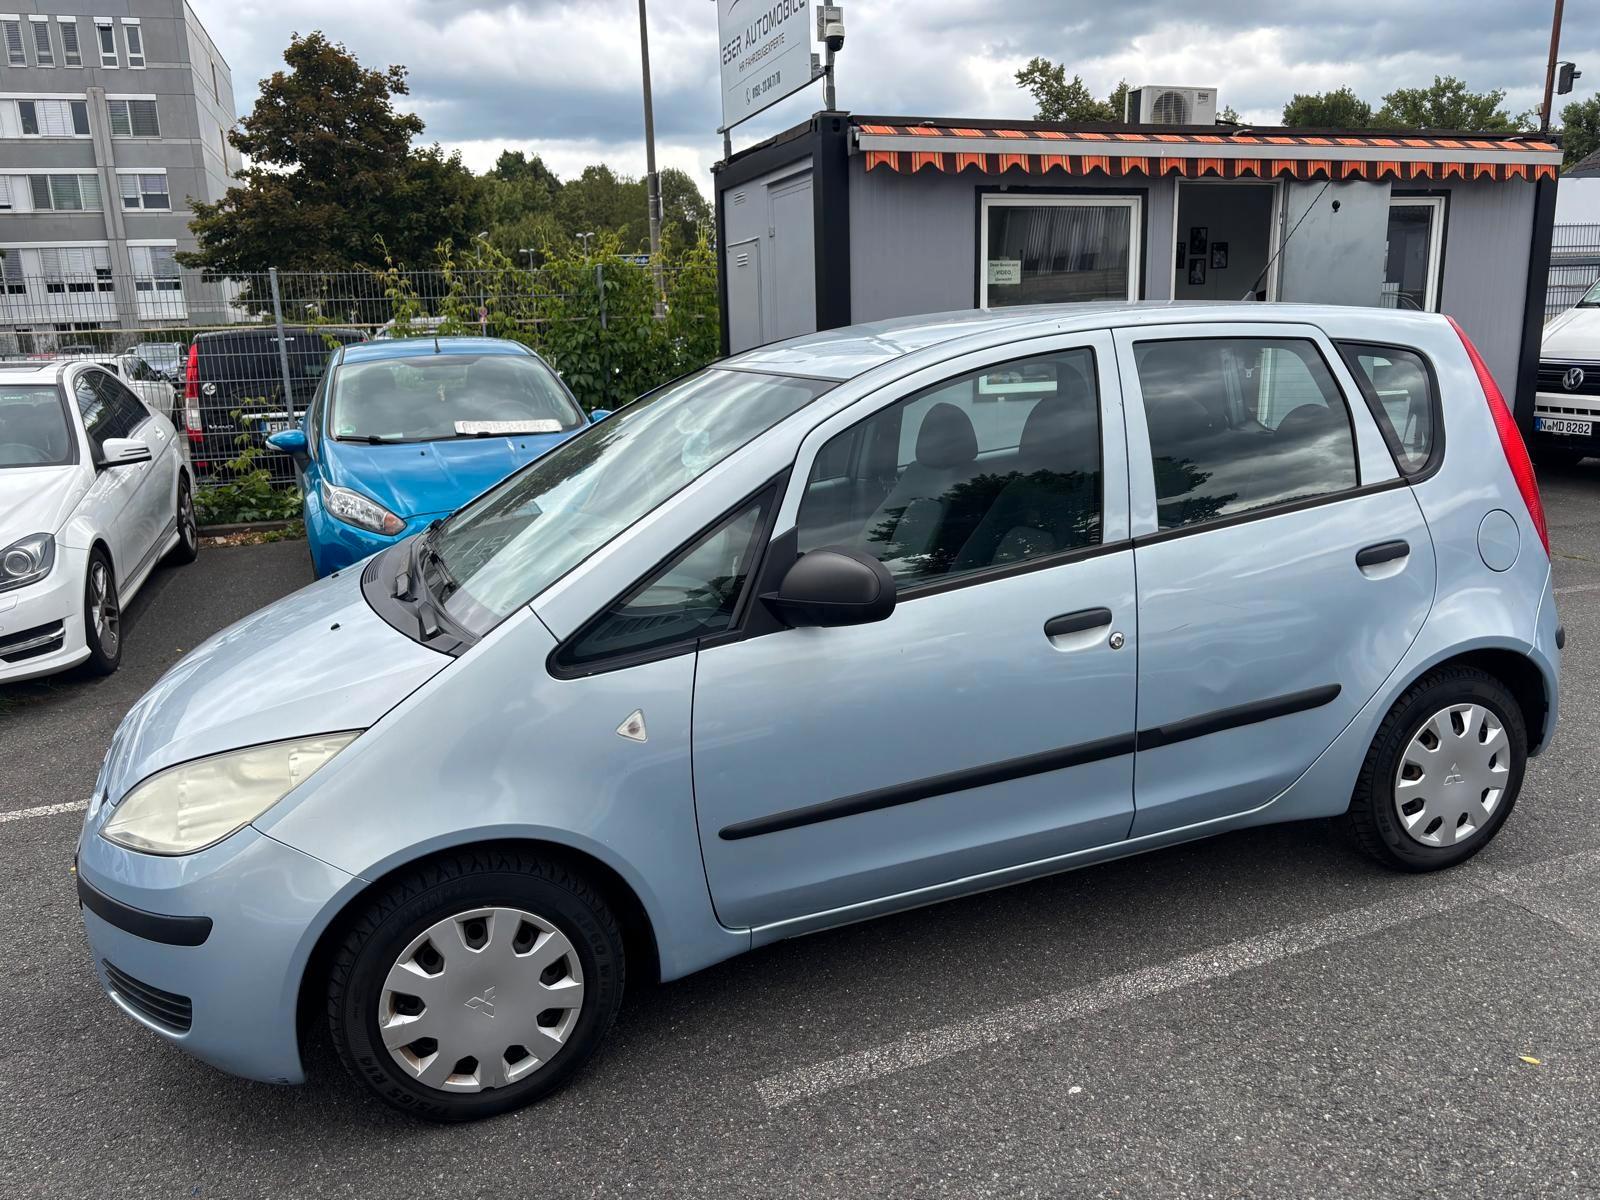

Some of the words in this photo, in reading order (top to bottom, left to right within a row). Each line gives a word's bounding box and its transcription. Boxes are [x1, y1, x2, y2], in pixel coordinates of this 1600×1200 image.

[722, 35, 742, 65] ESER
[745, 32, 785, 67] FAHRZEUGEXPERTE
[1540, 419, 1547, 430] N
[1552, 420, 1565, 432] MD
[1566, 421, 1590, 434] 8282
